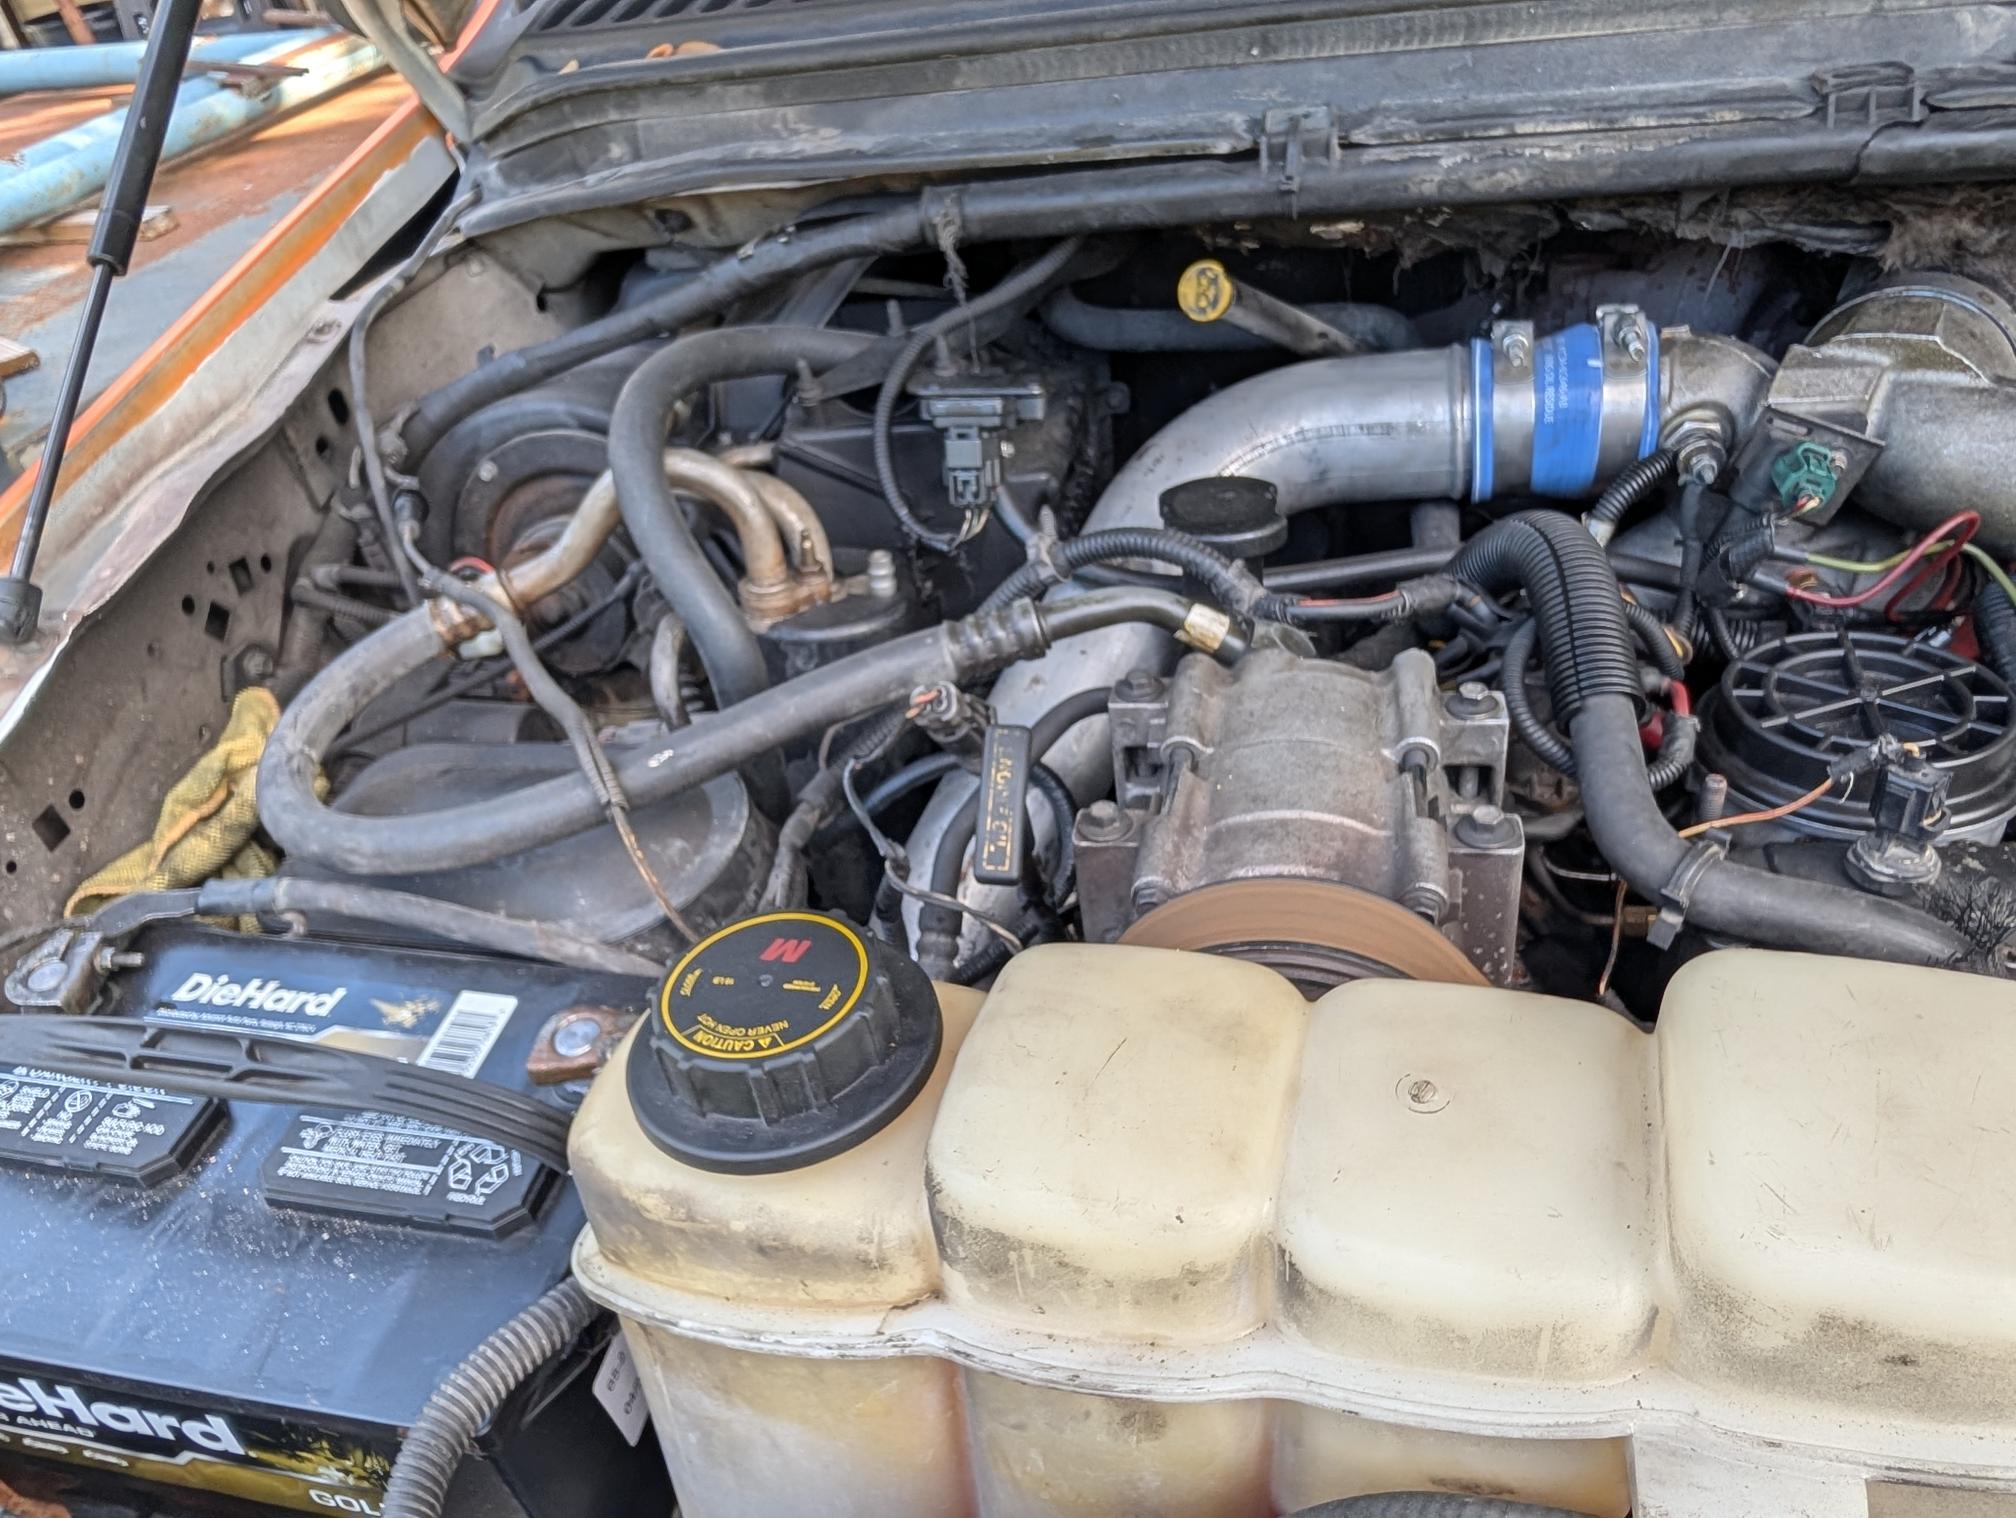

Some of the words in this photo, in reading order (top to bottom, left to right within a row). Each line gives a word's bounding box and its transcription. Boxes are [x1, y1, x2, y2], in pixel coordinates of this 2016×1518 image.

[760, 938, 812, 962] M
[171, 972, 347, 1017] DieHard
[697, 1013, 715, 1027] HOT
[715, 1022, 745, 1036] OPEN
[748, 1020, 789, 1037] NEVER
[692, 1030, 754, 1051] CAUTION
[309, 1488, 386, 1517] GOL
